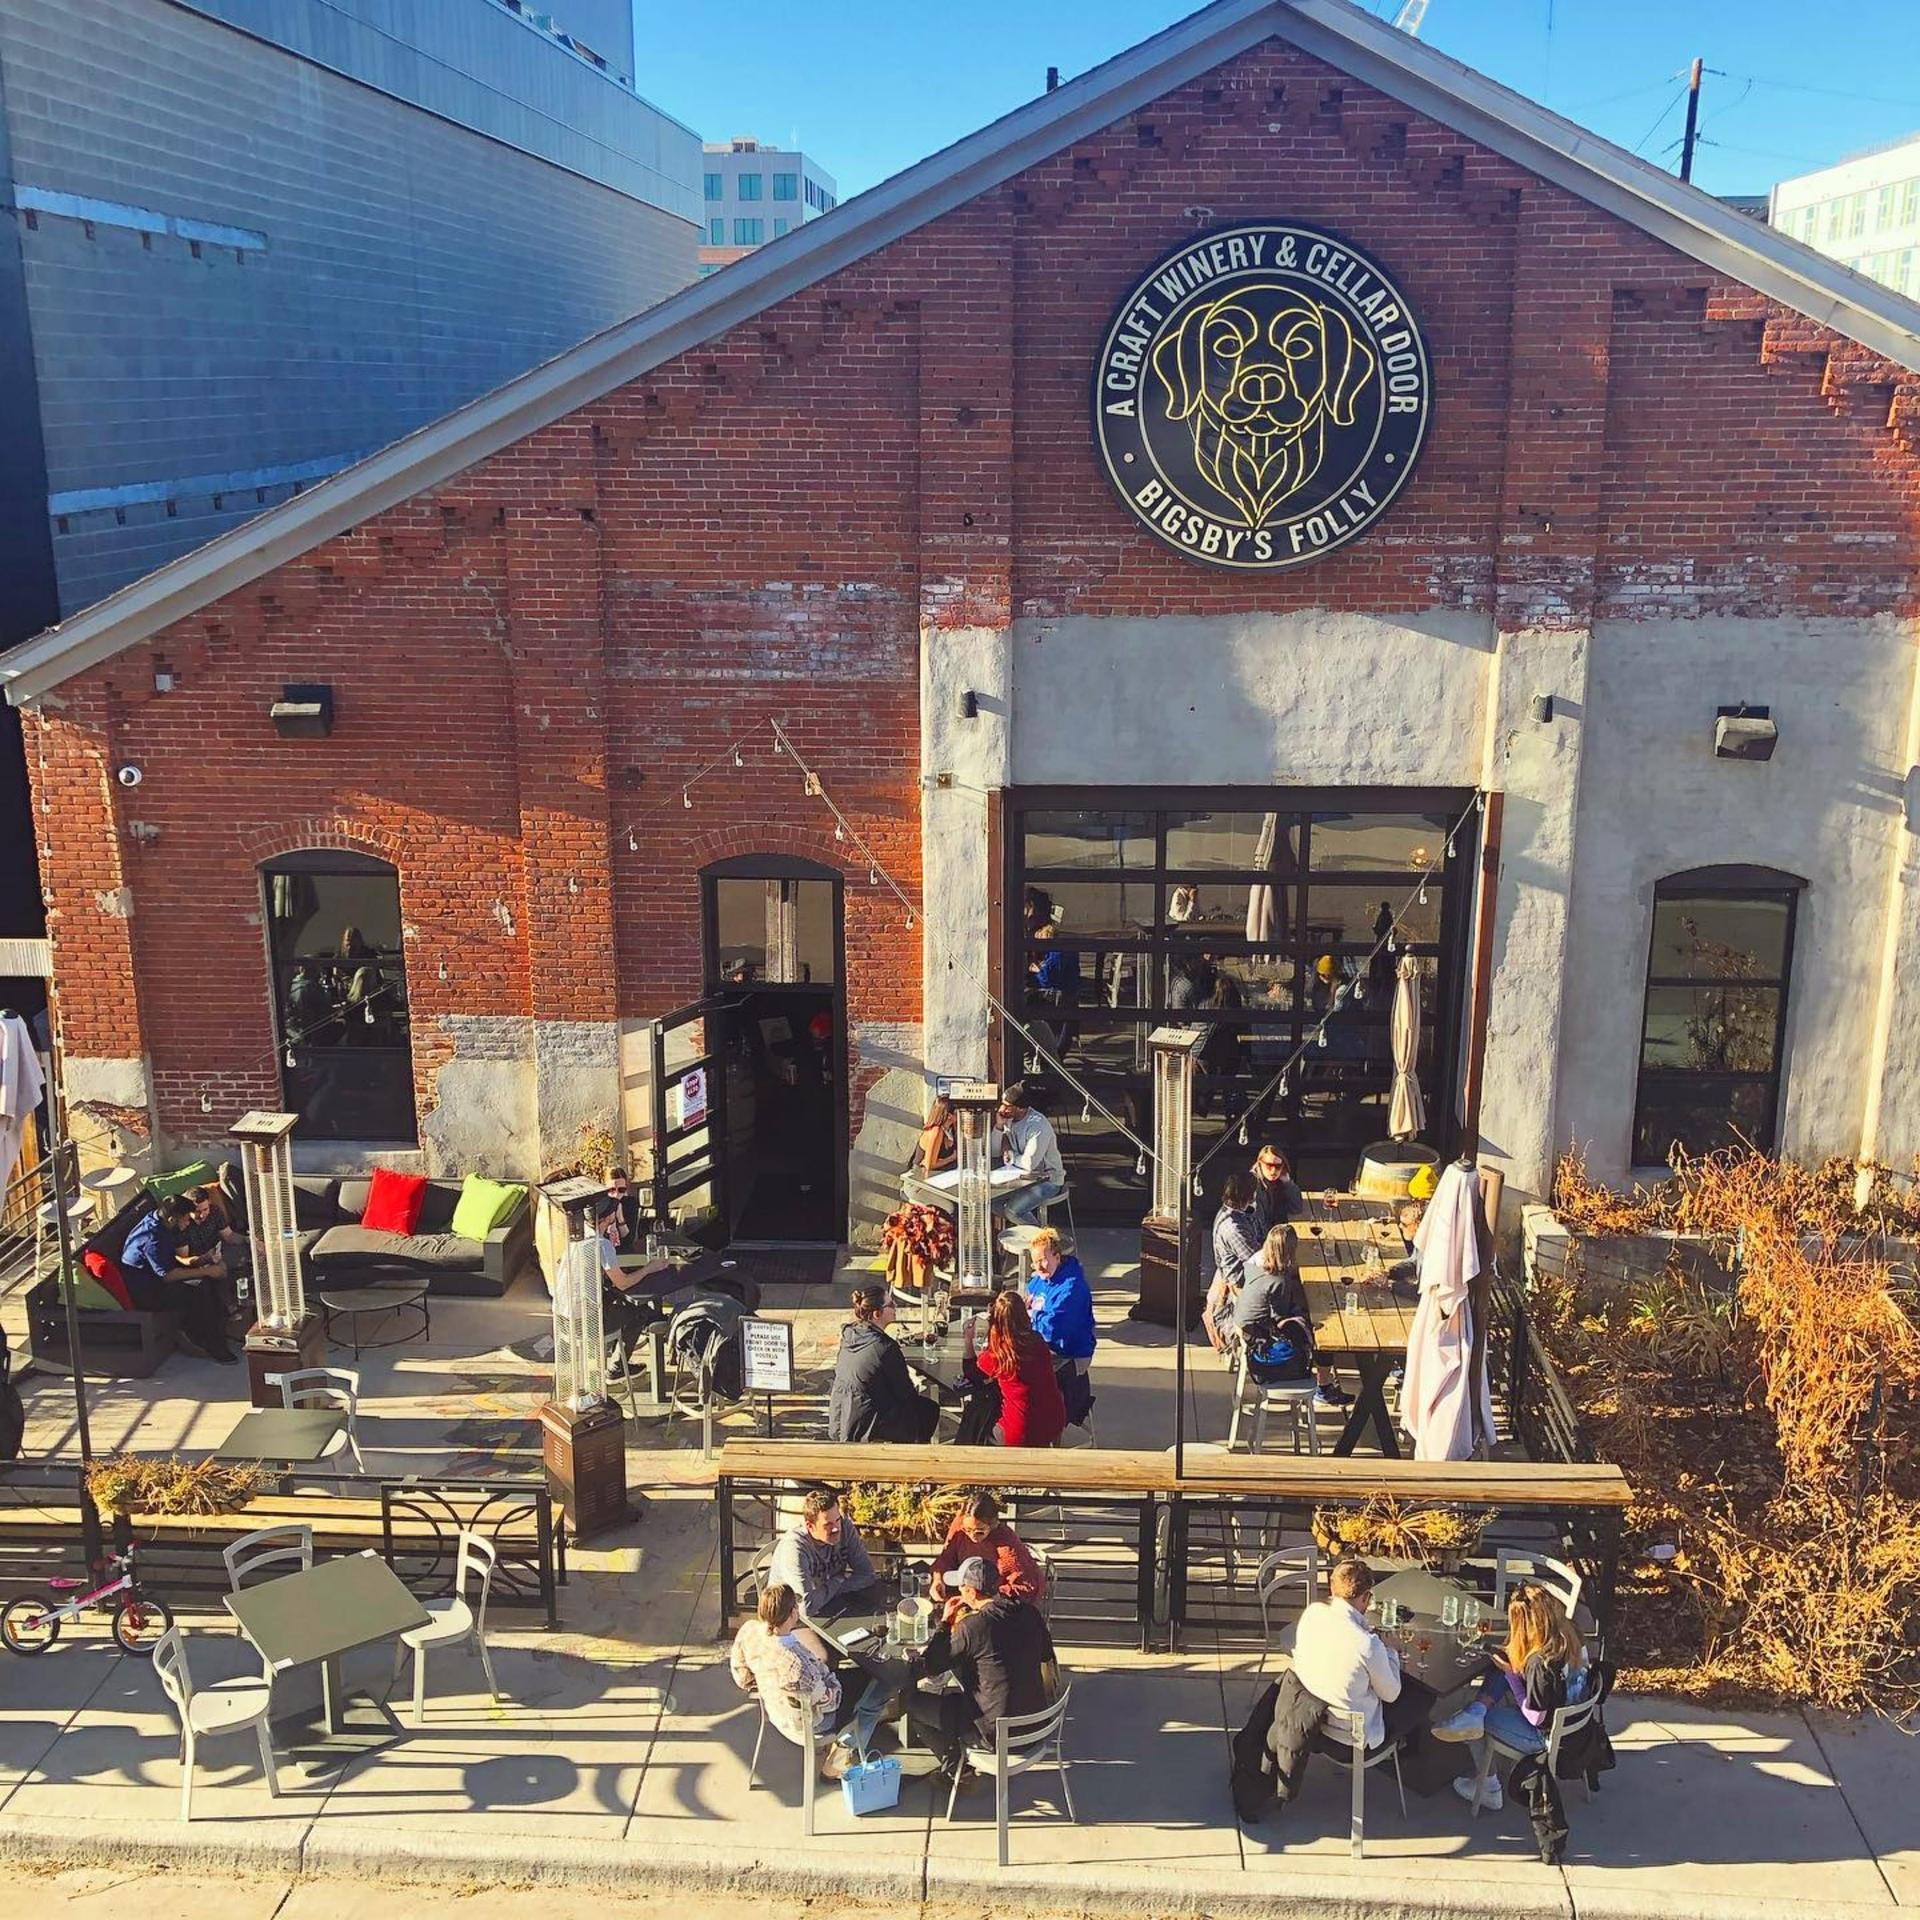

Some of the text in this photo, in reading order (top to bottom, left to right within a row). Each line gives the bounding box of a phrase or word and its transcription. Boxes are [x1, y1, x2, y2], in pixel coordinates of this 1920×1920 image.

[1106, 235, 1419, 417] A CRAFT WINERY & CELLAR DOOR
[1135, 479, 1378, 560] BIGSBY'S FOLLY
